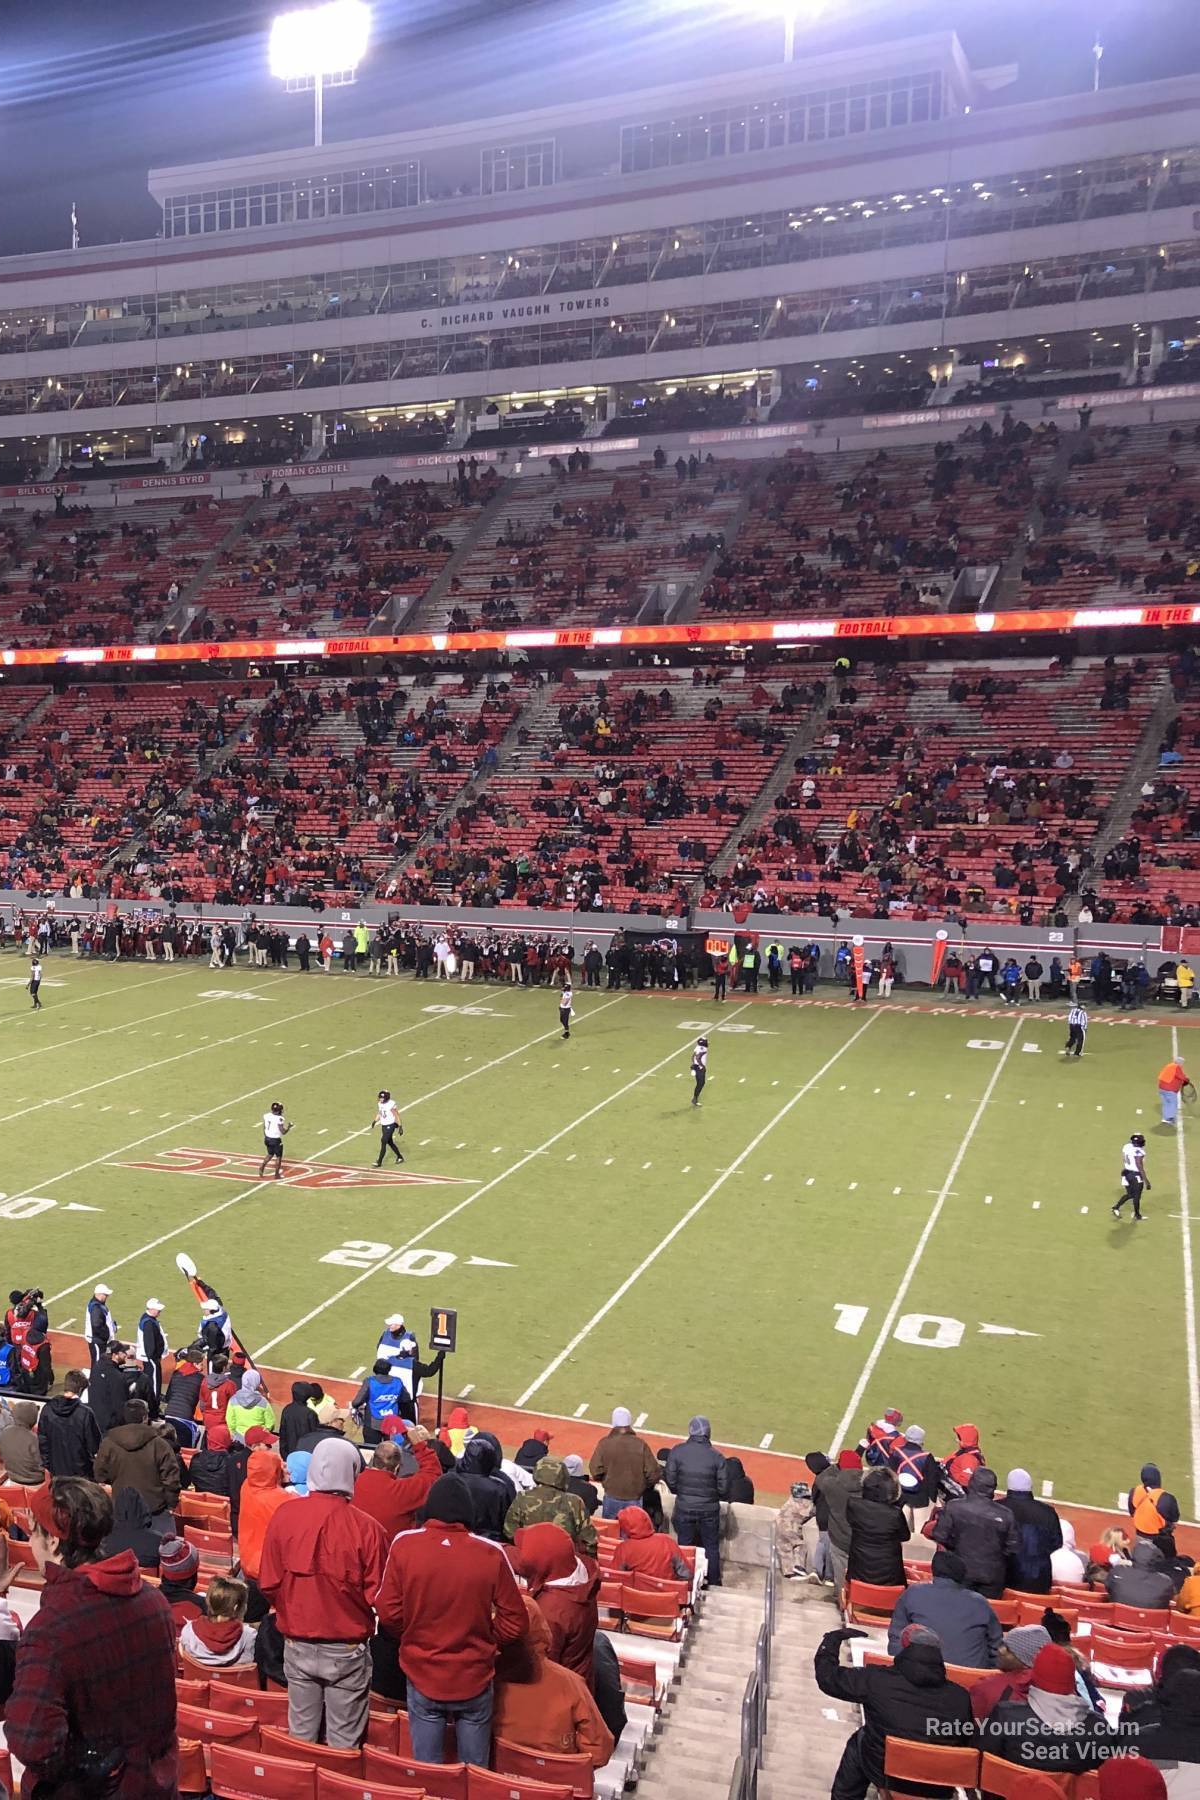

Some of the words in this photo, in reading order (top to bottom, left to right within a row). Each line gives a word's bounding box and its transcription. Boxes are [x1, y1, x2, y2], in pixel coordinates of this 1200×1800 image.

[421, 319, 433, 328] C.
[441, 311, 494, 326] RICHARD
[503, 304, 550, 319] VAUGHN
[560, 297, 610, 312] TOWERS
[947, 407, 983, 419] HOLT
[417, 456, 441, 466] DICK
[272, 466, 306, 478] ROMAN
[308, 463, 349, 476] GABRIEL
[142, 478, 177, 488] DENNIS
[179, 475, 205, 486] BYRD
[17, 486, 35, 496] BILL
[36, 485, 69, 496] YOEST
[1146, 610, 1162, 622] IN
[1165, 608, 1191, 621] THE
[838, 622, 894, 634] FOOTBALL
[557, 633, 569, 644] IN
[571, 632, 591, 643] THE
[327, 641, 370, 652] FOOTBALL
[105, 649, 115, 660] IN
[116, 648, 132, 659] THE
[666, 920, 678, 929] 22
[1048, 931, 1064, 942] 23
[976, 1008, 1161, 1025] STRNGTH
[676, 1021, 755, 1033] 20
[318, 1240, 458, 1277] 20
[437, 1313, 448, 1337] 1
[833, 1302, 966, 1349] 10
[211, 1390, 219, 1410] 1
